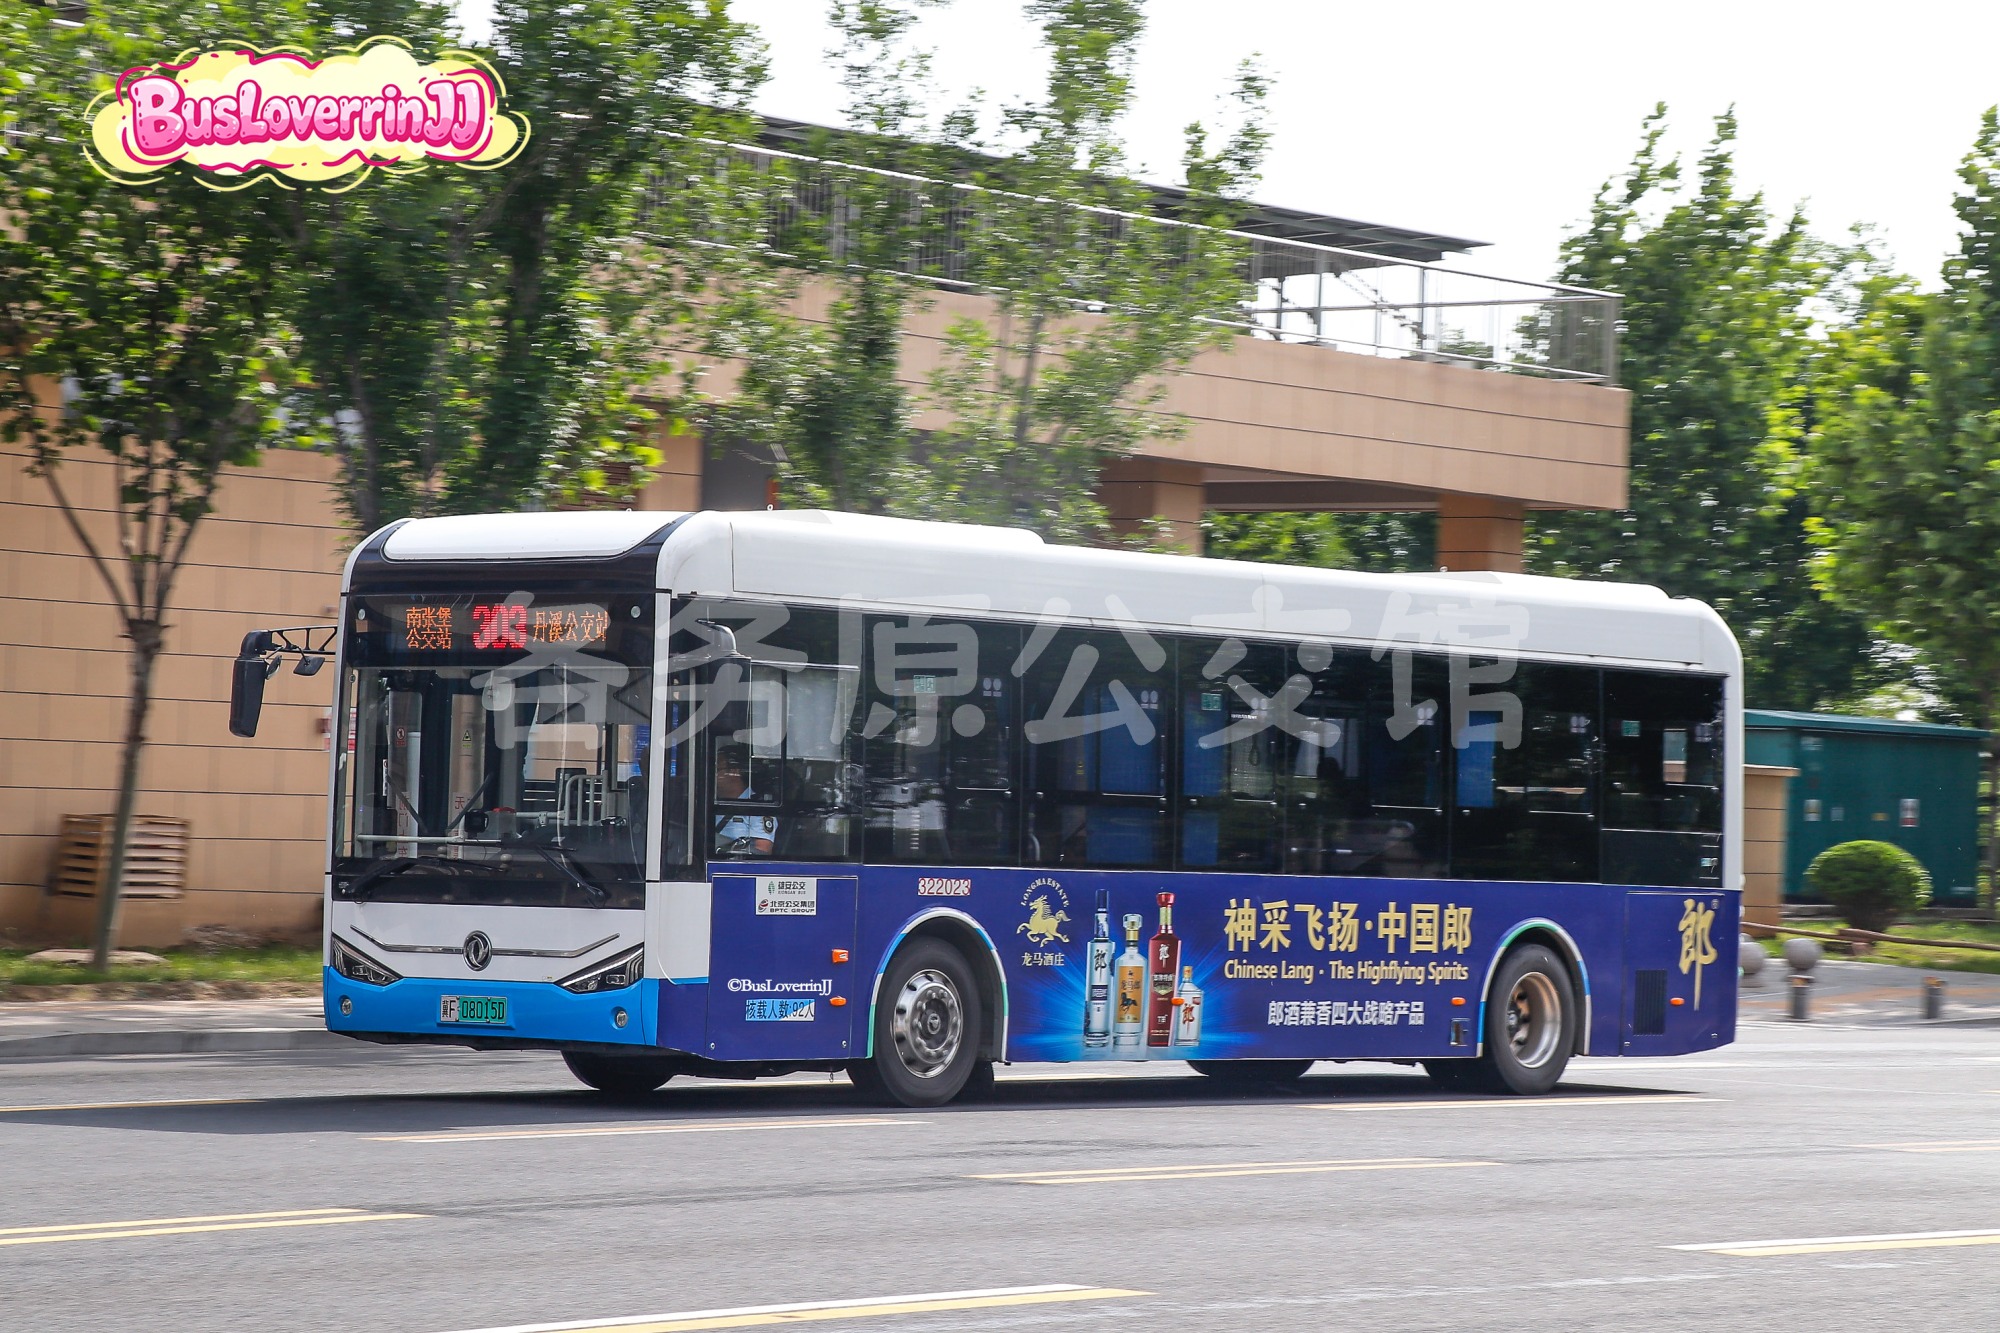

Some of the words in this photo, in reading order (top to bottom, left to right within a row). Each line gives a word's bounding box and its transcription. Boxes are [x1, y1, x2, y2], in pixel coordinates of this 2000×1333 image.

[405, 606, 453, 629] 南张堡
[472, 605, 528, 649] 303
[533, 610, 608, 643] 丹溪公交站
[405, 628, 453, 650] 公交站
[777, 881, 806, 890] 雄安公交
[918, 878, 971, 896] 322023
[770, 900, 815, 908] 北京公交集团
[1021, 952, 1065, 967] 龙马酒庄
[1224, 959, 1278, 979] Chinese
[1280, 960, 1315, 985] Lang
[1328, 960, 1354, 979] The
[1357, 960, 1426, 985] Highflying
[1427, 961, 1469, 985] Spirits
[746, 999, 814, 1019] 核载人数:92人
[1267, 1000, 1425, 1026] 郎酒兼香四大战略产品
